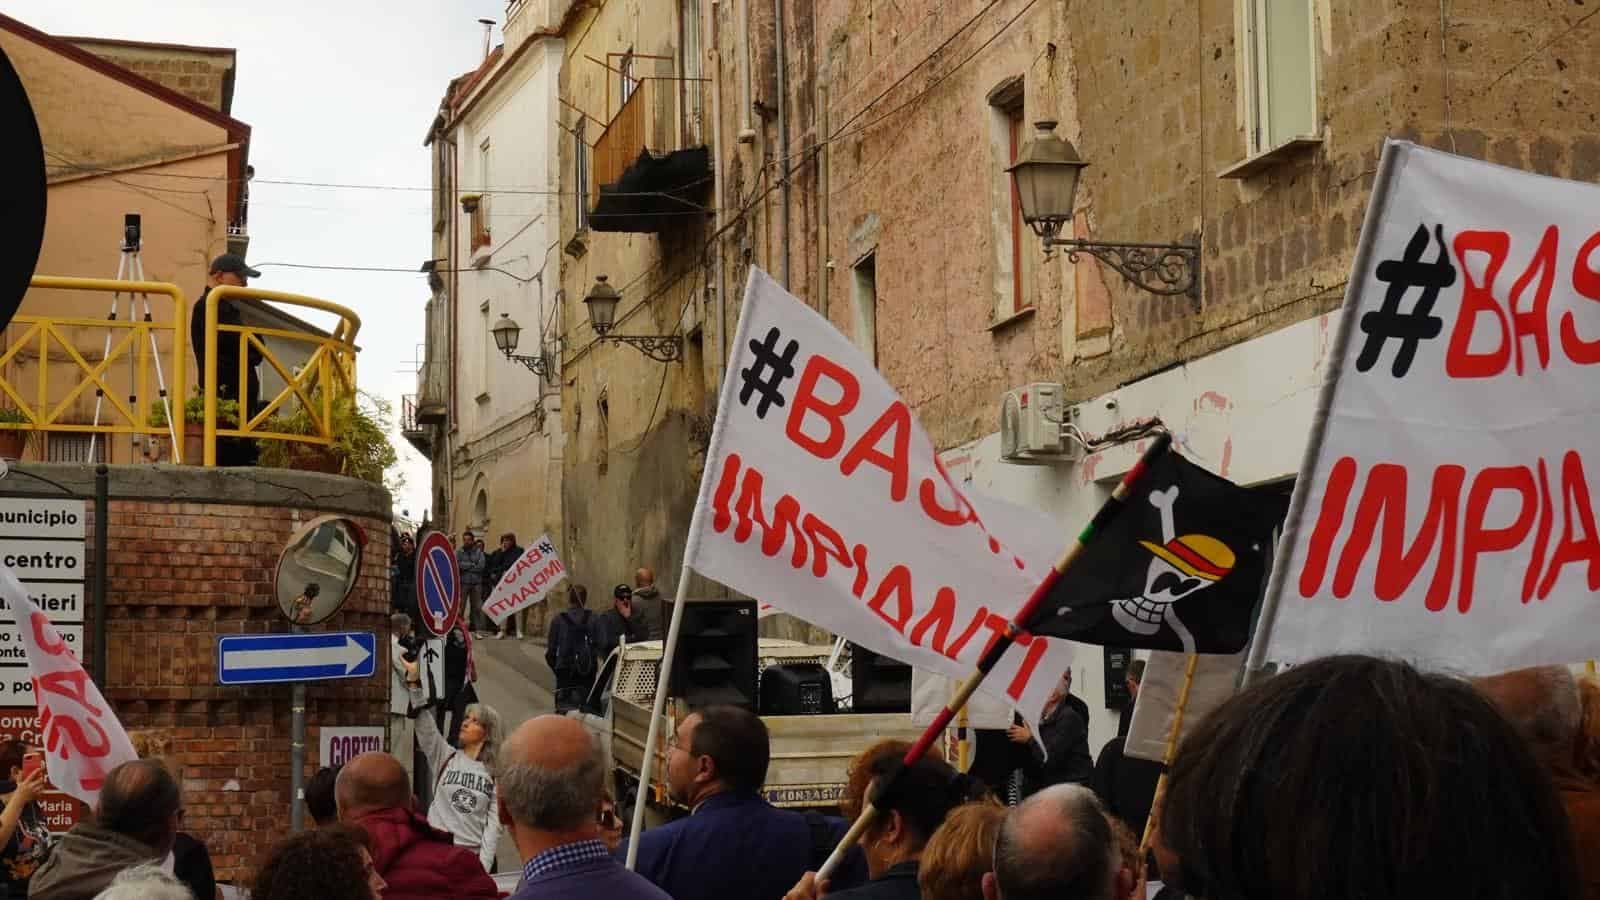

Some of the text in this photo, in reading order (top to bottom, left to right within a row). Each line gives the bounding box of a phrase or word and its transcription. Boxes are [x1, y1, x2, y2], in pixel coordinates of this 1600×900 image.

[0, 509, 77, 527] unicipio
[1299, 450, 1600, 614] IMPIA
[4, 552, 77, 569] centro
